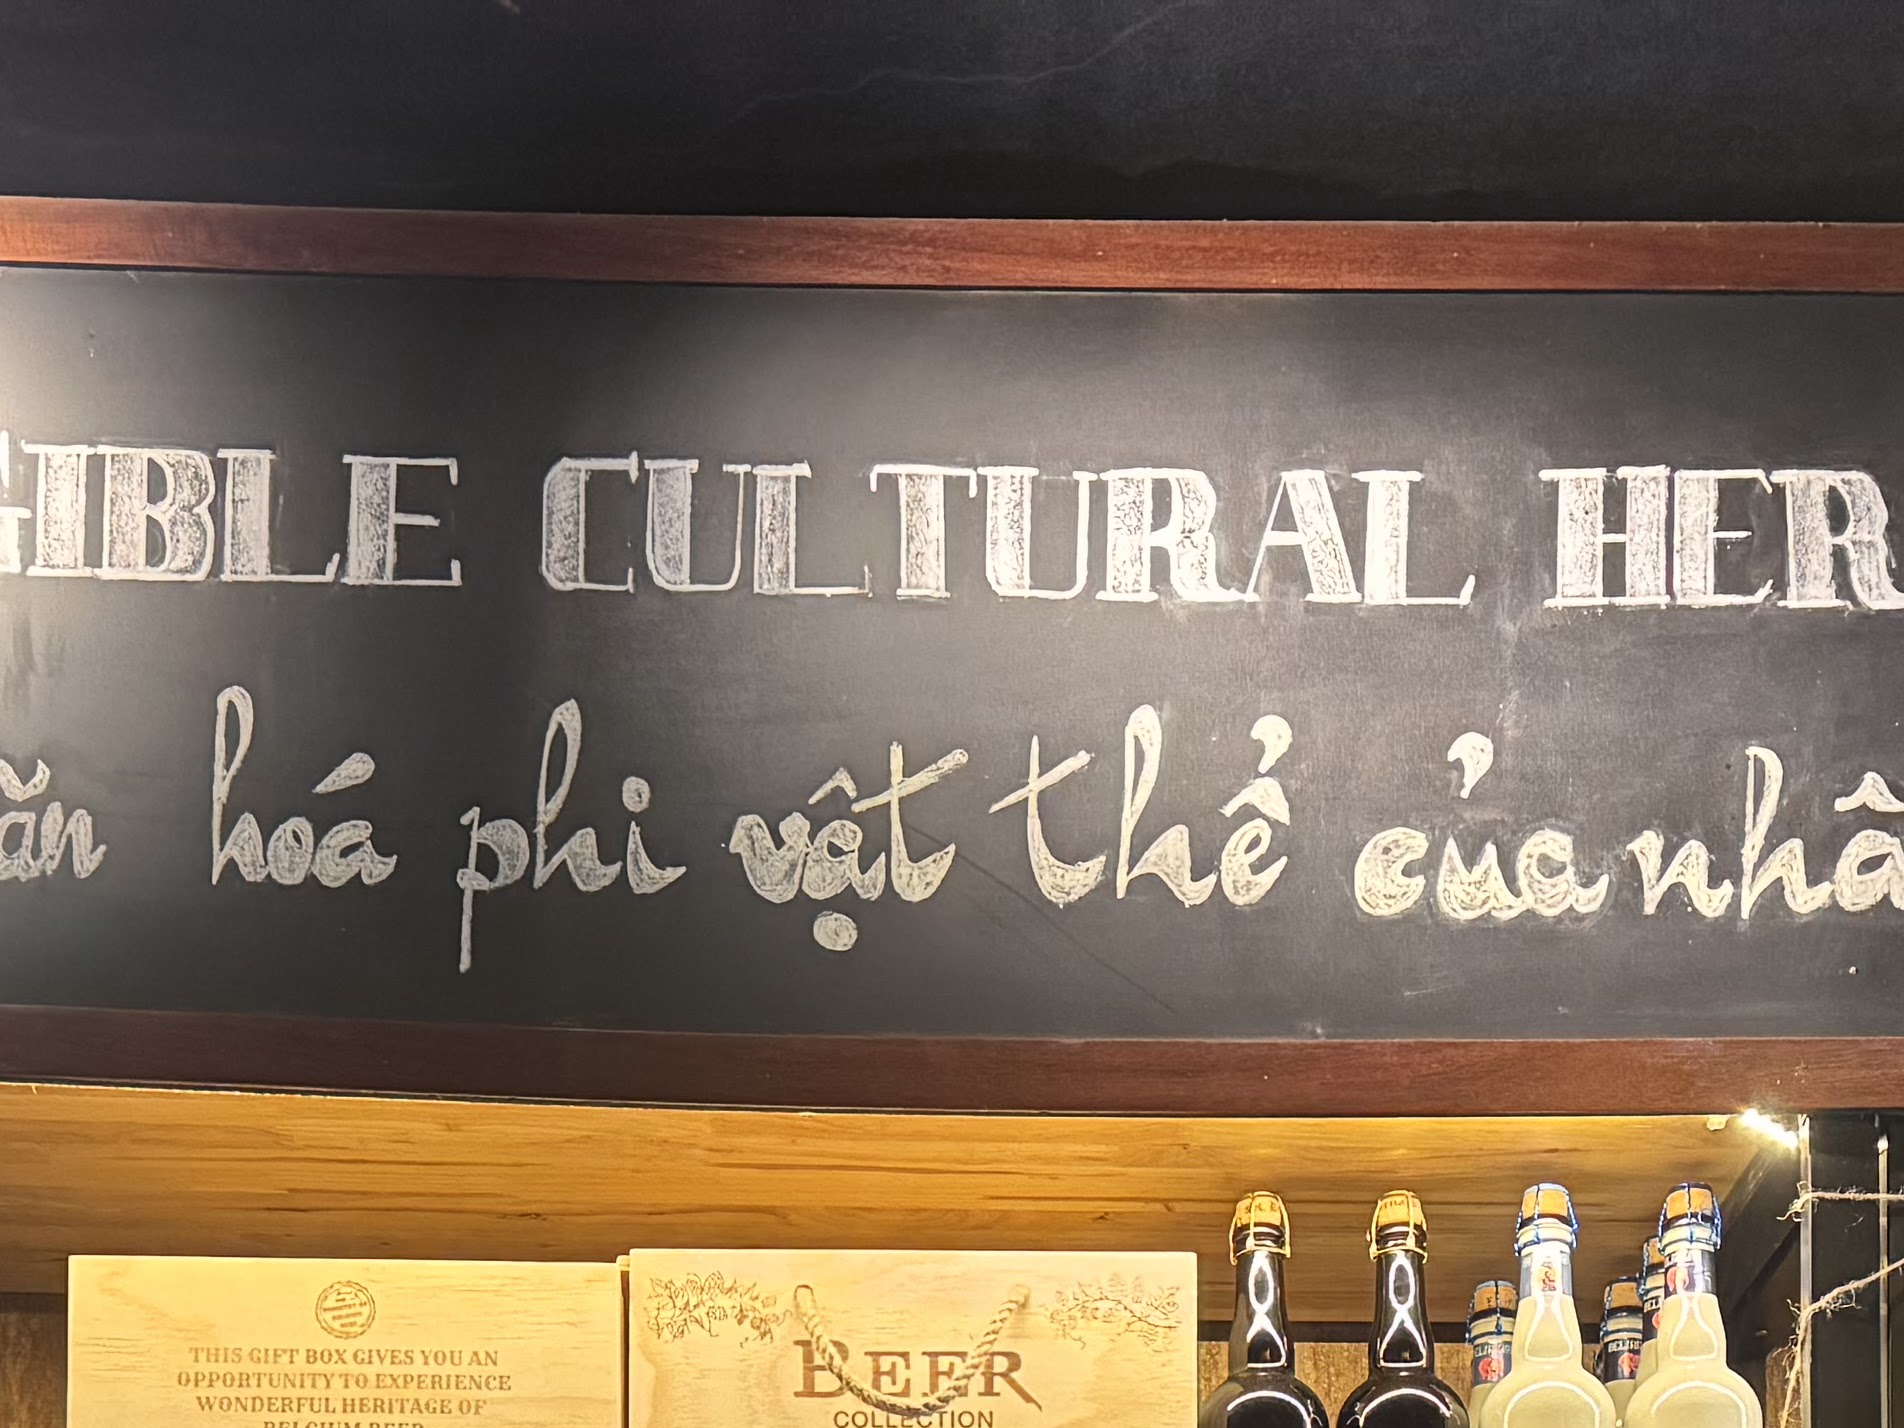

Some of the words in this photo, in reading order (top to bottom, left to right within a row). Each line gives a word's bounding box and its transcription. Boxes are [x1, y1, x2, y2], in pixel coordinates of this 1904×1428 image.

[539, 455, 1476, 608] CULTURAL
[458, 700, 685, 973] phi
[732, 741, 970, 950] vật
[989, 706, 1290, 907] thể
[189, 1347, 245, 1365] THIS
[248, 1348, 299, 1366] GIFT
[305, 1349, 349, 1366] BOX
[352, 1350, 415, 1367] GIVES
[421, 1350, 465, 1367] YOU
[467, 1350, 499, 1367] AN
[176, 1371, 336, 1390] OPPORTUNITY
[338, 1372, 368, 1390] TO
[374, 1373, 512, 1391] EXPERIENCE
[793, 1339, 1042, 1411] BEER
[196, 1396, 336, 1414] WONDERFUL
[342, 1397, 452, 1415] HERITAGE
[458, 1398, 487, 1415] OF
[833, 1409, 993, 1428] COLLECTION
